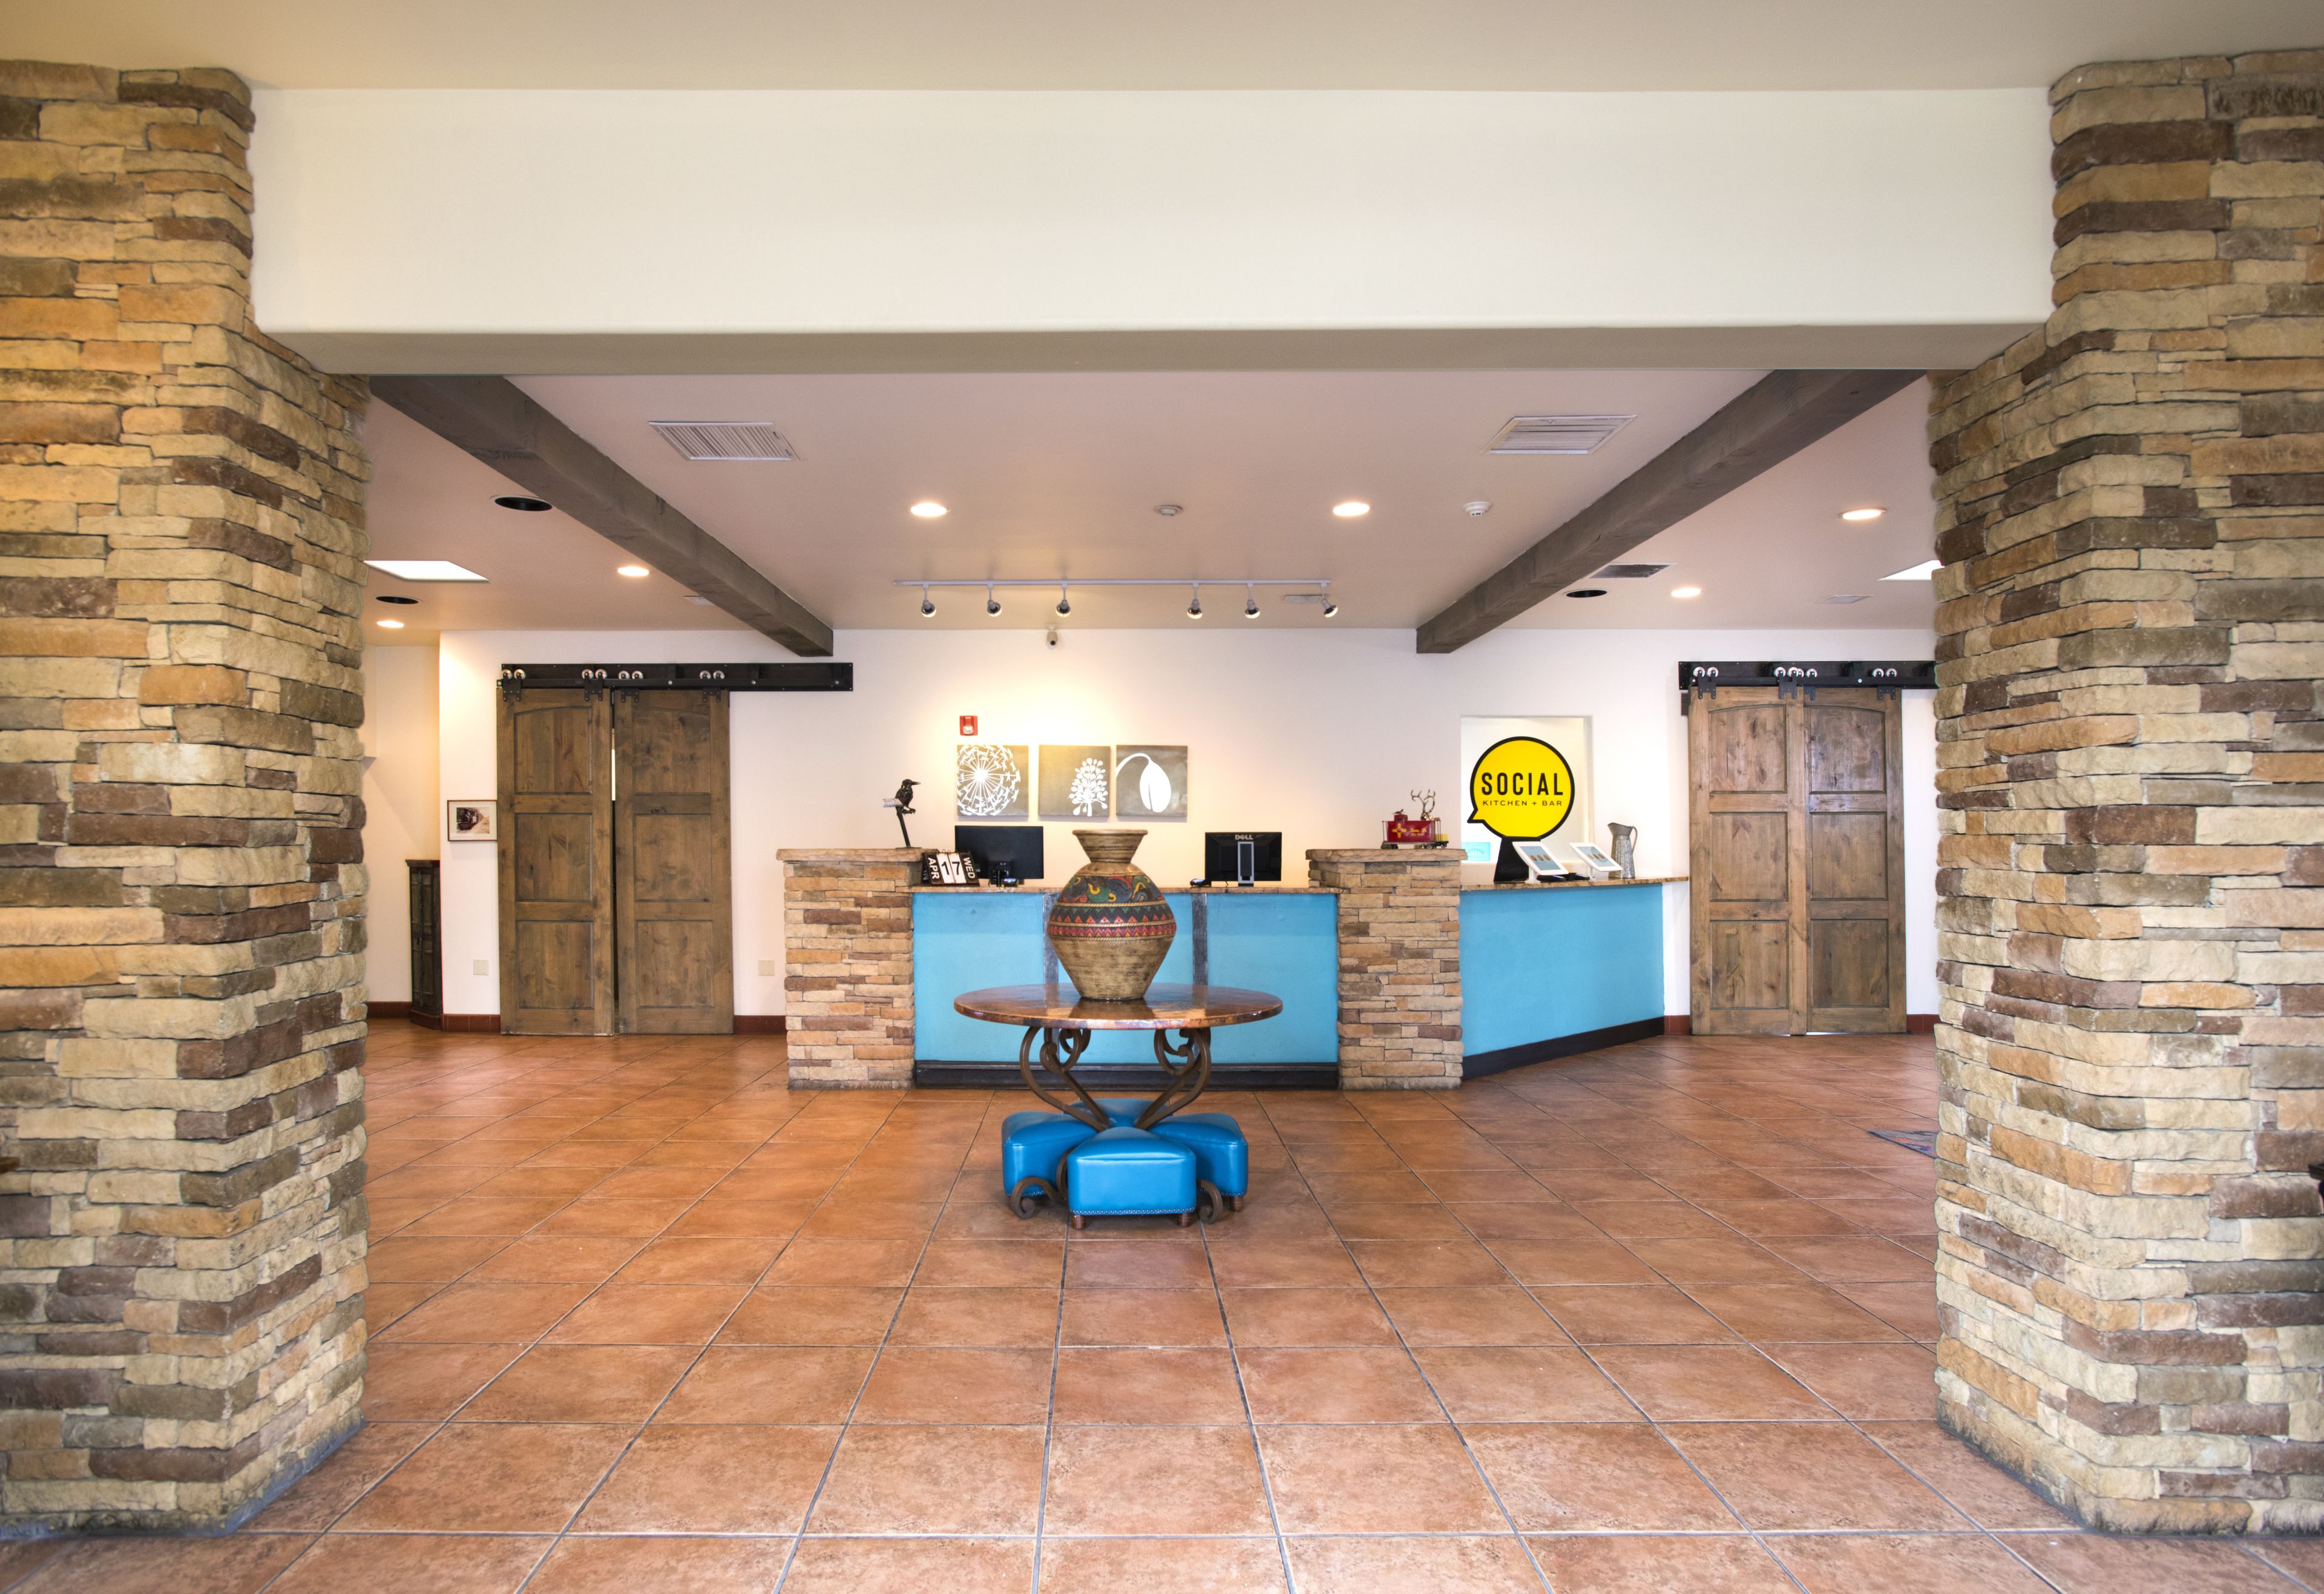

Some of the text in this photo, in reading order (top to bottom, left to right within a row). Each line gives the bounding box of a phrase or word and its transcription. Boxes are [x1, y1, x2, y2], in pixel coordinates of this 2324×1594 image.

[1481, 772, 1563, 795] SOCIAL
[927, 857, 940, 880] APR
[941, 861, 960, 875] 17
[963, 857, 976, 879] WED
